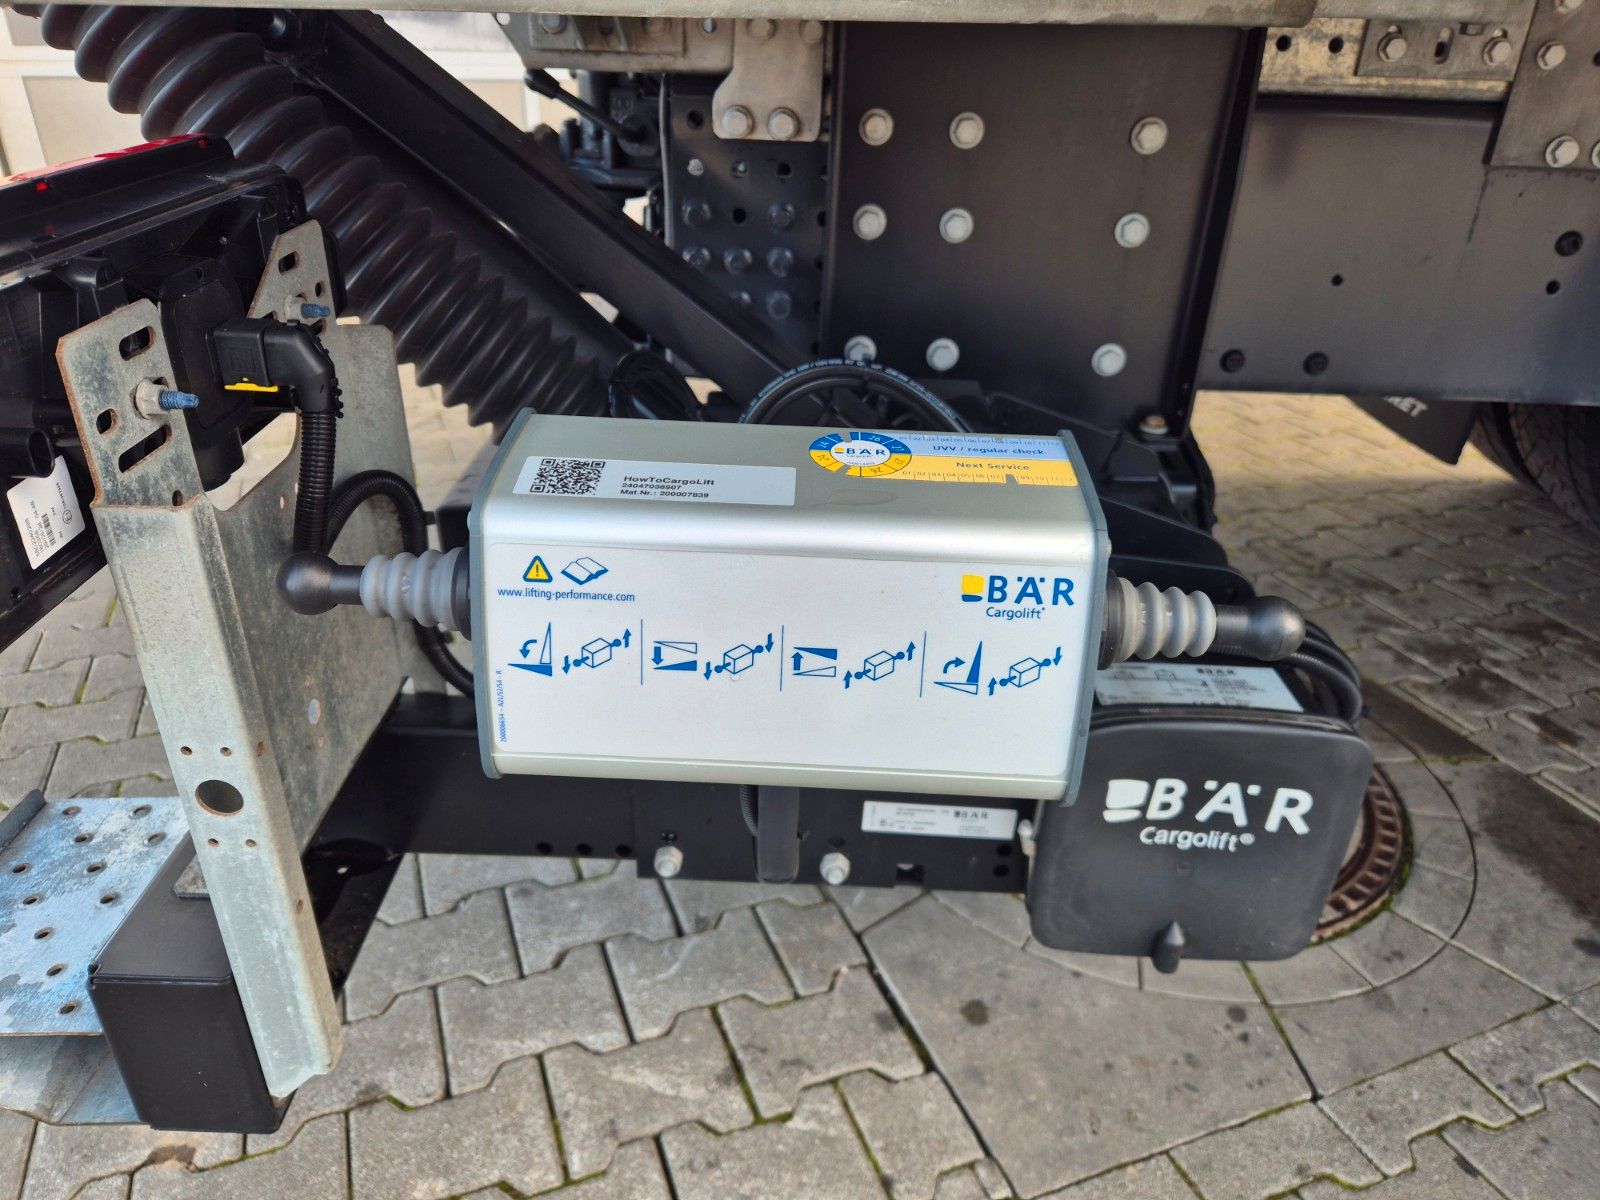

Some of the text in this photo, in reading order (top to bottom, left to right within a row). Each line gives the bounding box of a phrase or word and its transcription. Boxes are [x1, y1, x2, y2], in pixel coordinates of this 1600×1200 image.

[987, 463, 1030, 471] Service
[623, 475, 715, 485] HowToCargoLift
[497, 587, 636, 602] www.lifting-performance.com
[987, 575, 1074, 606] BÄR
[1146, 778, 1313, 835] BÄR
